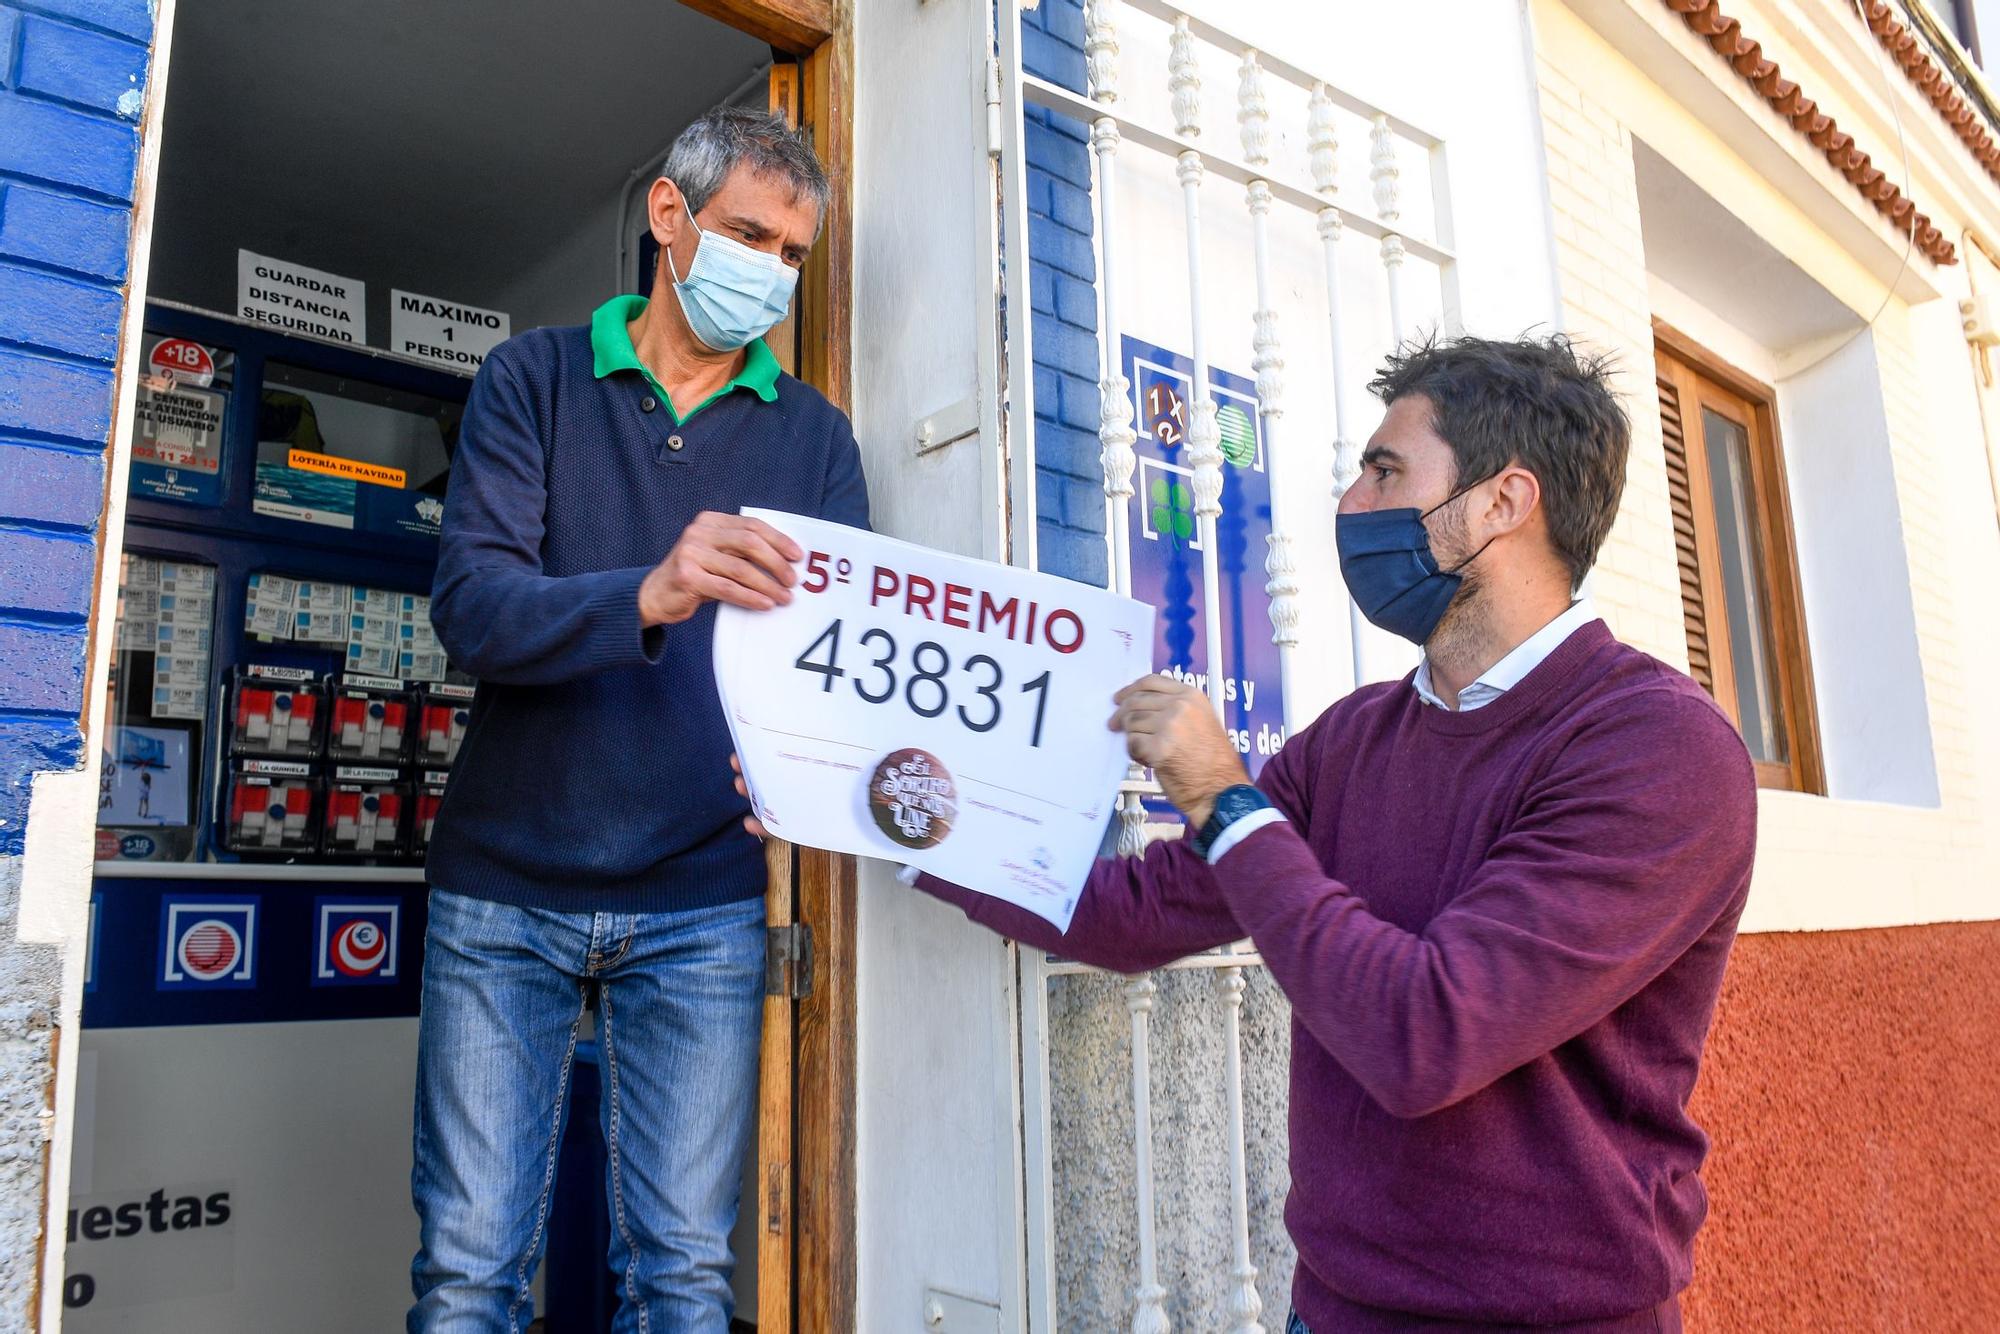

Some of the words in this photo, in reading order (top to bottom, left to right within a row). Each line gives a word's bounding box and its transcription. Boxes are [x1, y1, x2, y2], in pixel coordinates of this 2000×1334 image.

[255, 266, 346, 299] GUARDAR
[249, 286, 351, 322] DISTANCIA
[400, 296, 500, 329] MAXIMO
[242, 305, 353, 342] SEGURIDAD
[443, 327, 454, 342] 1
[164, 344, 200, 366] +18
[136, 401, 151, 410] DE
[155, 403, 219, 423] ATENCIÓN
[153, 392, 204, 410] CENTRO
[137, 410, 154, 420] AL
[158, 412, 215, 432] USUARIO
[292, 454, 337, 471] LOTERÍA
[339, 463, 354, 473] DE
[355, 466, 403, 483] NAVIDAD
[802, 550, 852, 594] 5º
[869, 565, 1085, 654] PREMIO
[794, 618, 1053, 748] 43831
[1242, 680, 1255, 712] y
[271, 766, 306, 774] QUINIELA
